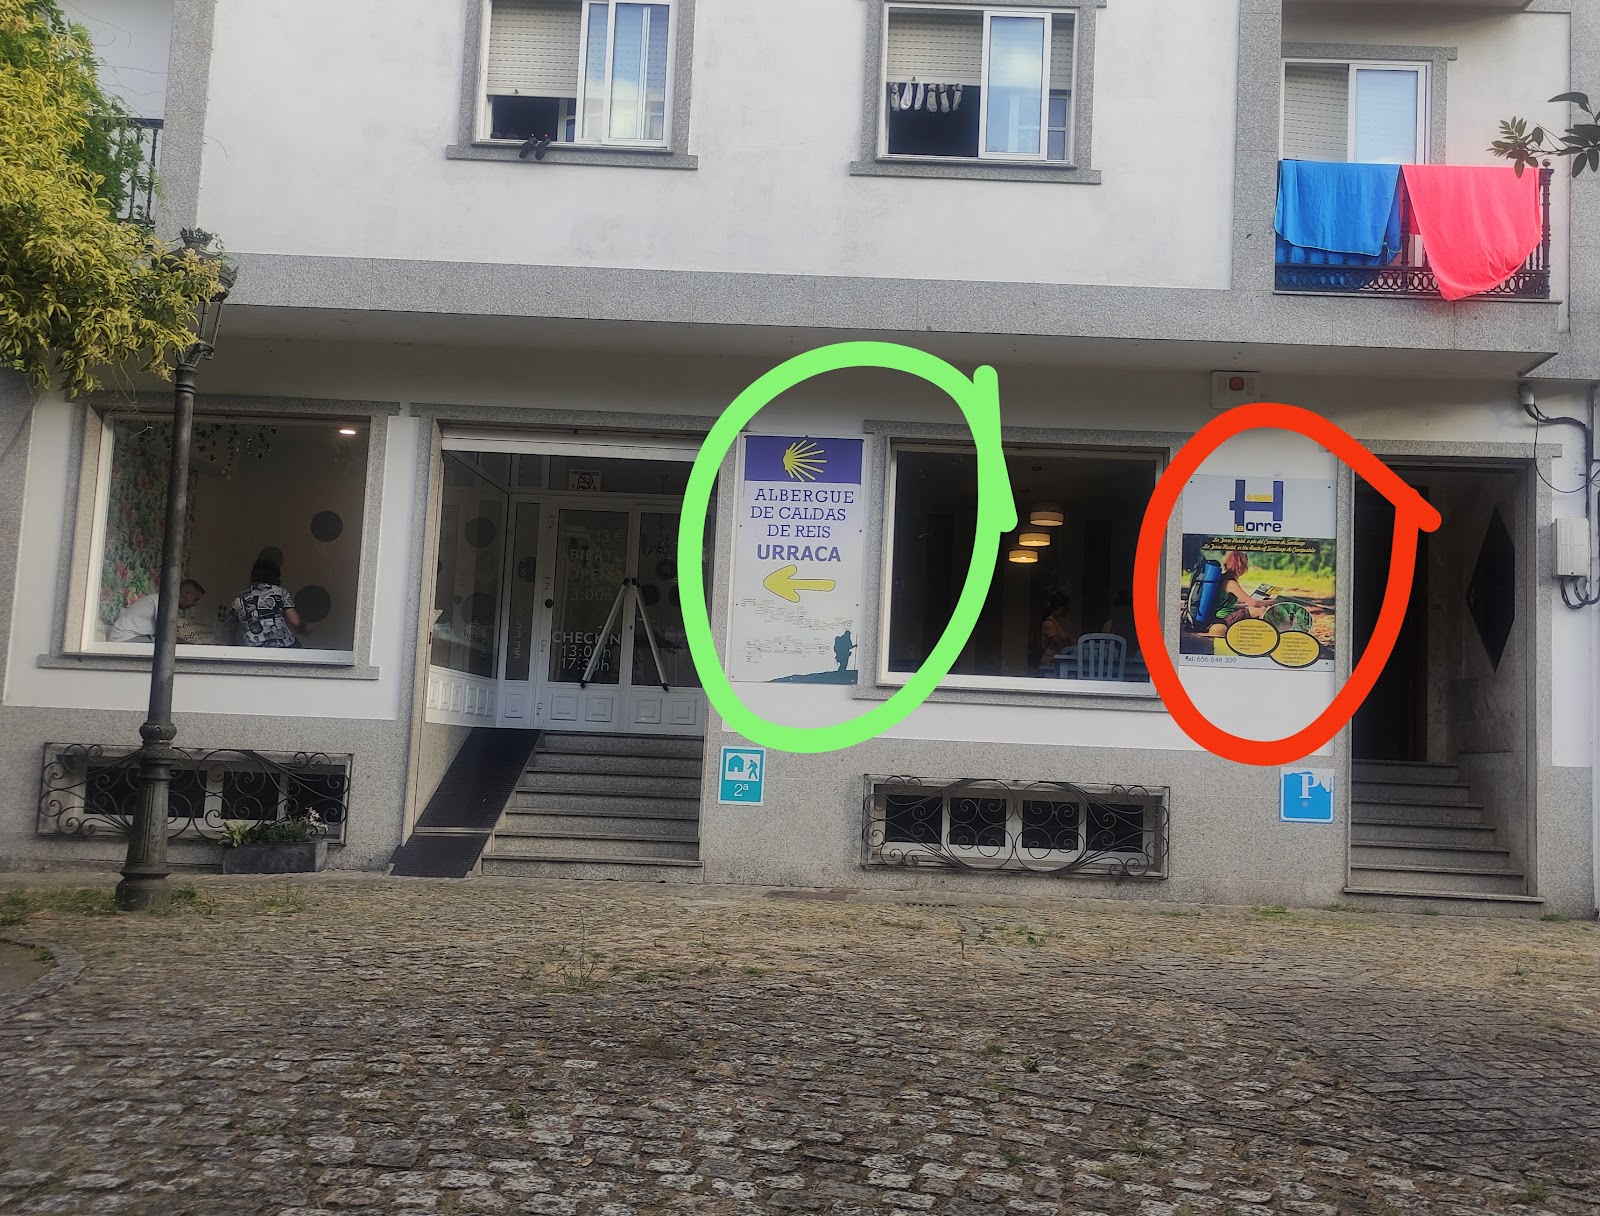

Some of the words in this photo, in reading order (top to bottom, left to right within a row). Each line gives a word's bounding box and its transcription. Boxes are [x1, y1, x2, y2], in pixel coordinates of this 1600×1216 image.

[755, 488, 854, 504] ALBERGUE
[750, 506, 774, 519] DE
[779, 506, 846, 521] CALDAS
[767, 524, 791, 537] DE
[795, 524, 831, 539] REIS
[757, 544, 841, 562] URRACA
[561, 644, 611, 658] 13:0h
